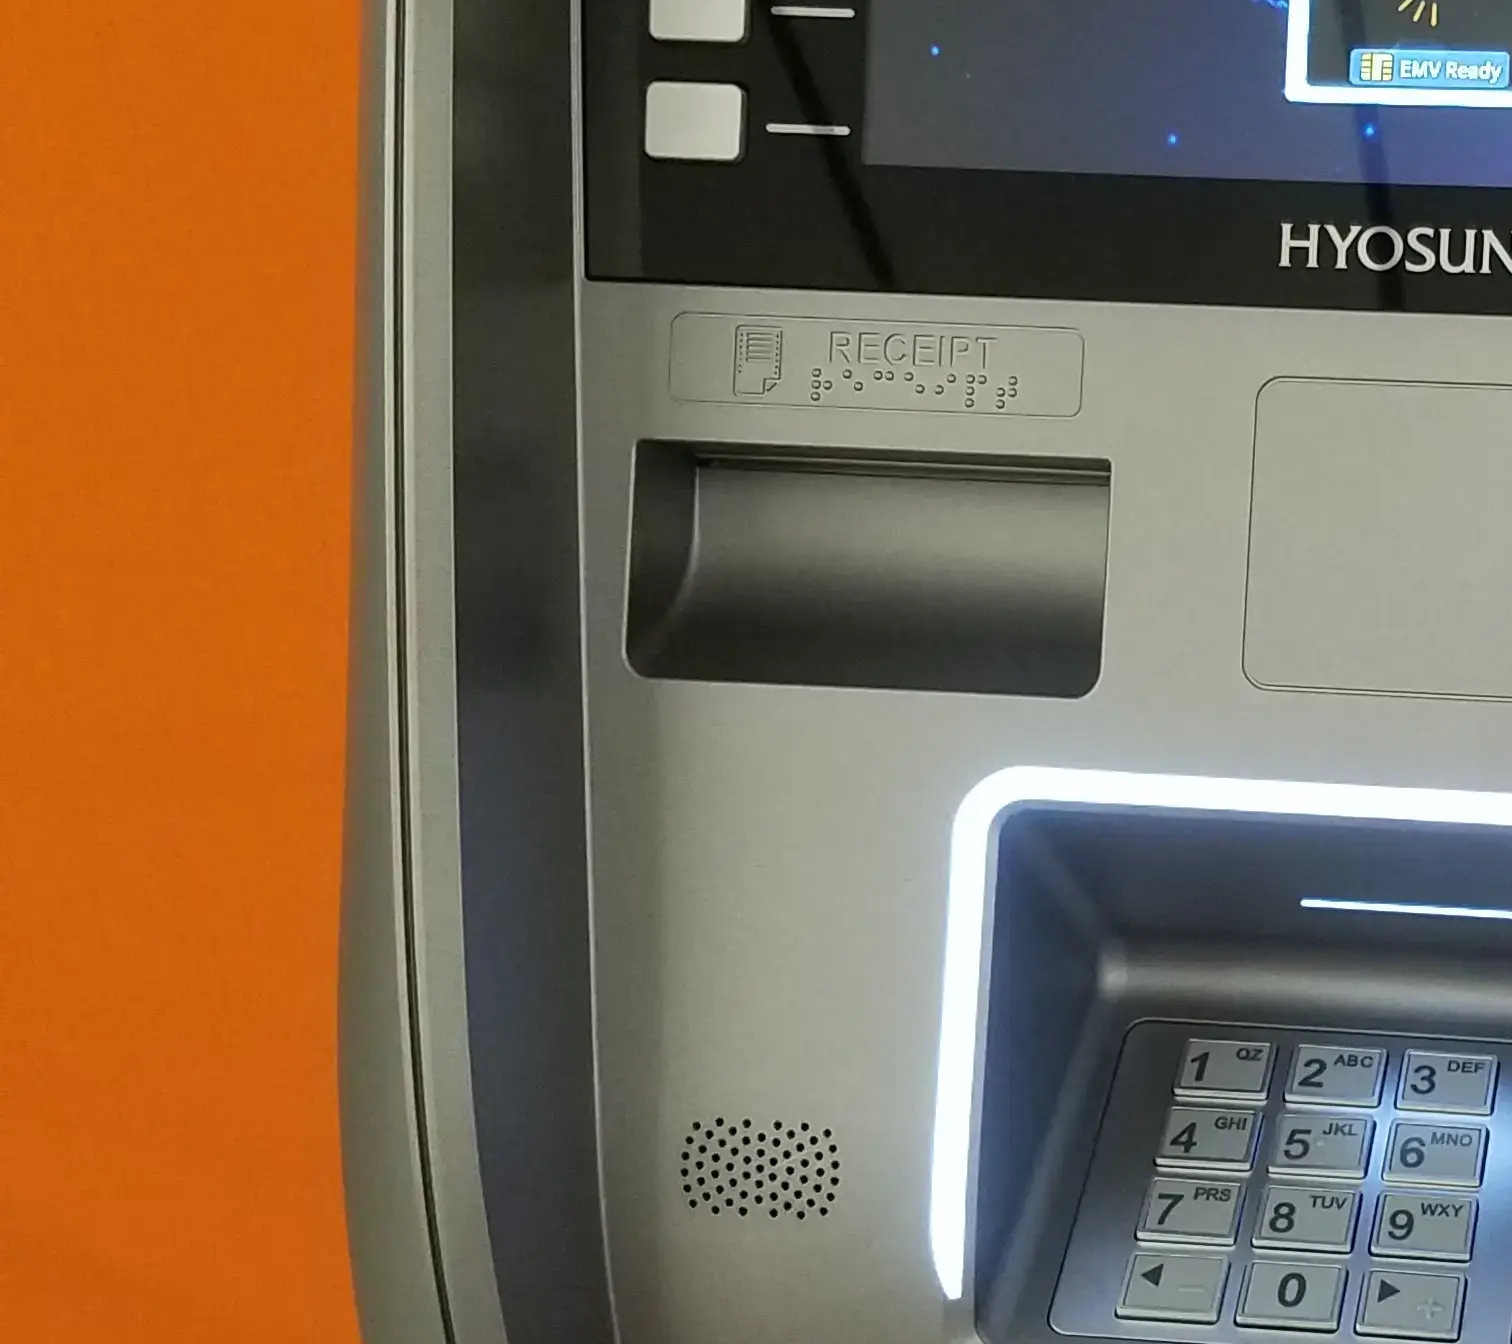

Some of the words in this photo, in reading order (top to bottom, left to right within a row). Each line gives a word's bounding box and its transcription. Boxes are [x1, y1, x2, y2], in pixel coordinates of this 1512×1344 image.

[1399, 59, 1443, 80] EMV
[1445, 59, 1502, 84] Ready
[828, 329, 999, 369] RECEIPT
[1190, 1052, 1211, 1081] 1
[1298, 1057, 1327, 1089] 2
[1333, 1054, 1374, 1069] ABC
[1410, 1064, 1437, 1096] 3
[1447, 1059, 1486, 1075] DEF
[1170, 1122, 1198, 1154] 4
[1214, 1115, 1247, 1131] GHI
[1283, 1128, 1311, 1160] 5
[1322, 1122, 1359, 1138] JKL
[1399, 1137, 1427, 1169] 6
[1431, 1131, 1473, 1148] MNO
[1157, 1193, 1184, 1225] 7
[1194, 1187, 1232, 1202] PRS
[1269, 1202, 1297, 1234] 8
[1309, 1194, 1347, 1211] TUV
[1387, 1209, 1415, 1241] 9
[1421, 1202, 1464, 1218] WXY
[1278, 1272, 1307, 1307] 0
